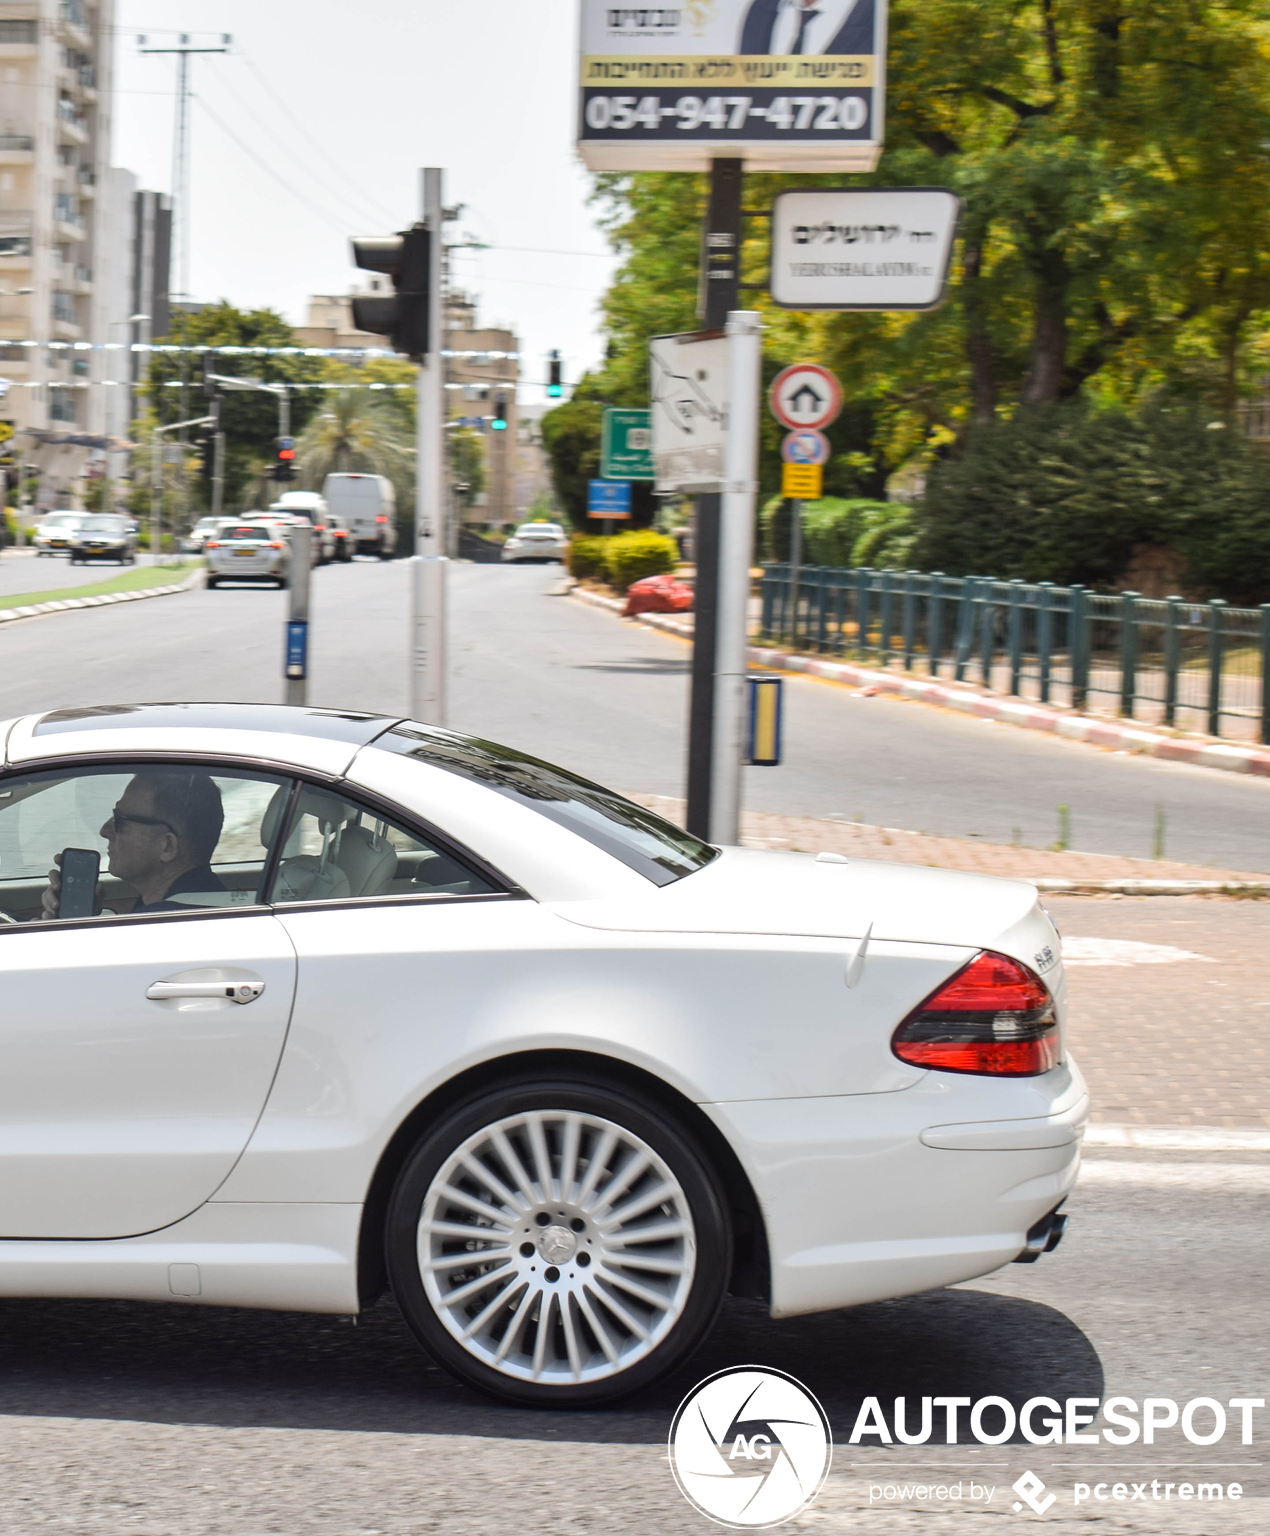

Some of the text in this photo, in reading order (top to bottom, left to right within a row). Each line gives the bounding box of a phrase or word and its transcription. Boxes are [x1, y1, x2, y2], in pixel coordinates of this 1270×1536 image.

[588, 58, 869, 83] פגישת ייעוץ ללא התחייבות
[585, 96, 869, 130] 054-947-4720
[791, 221, 901, 244] ירושלים
[789, 262, 917, 277] YERUSHALAYIM
